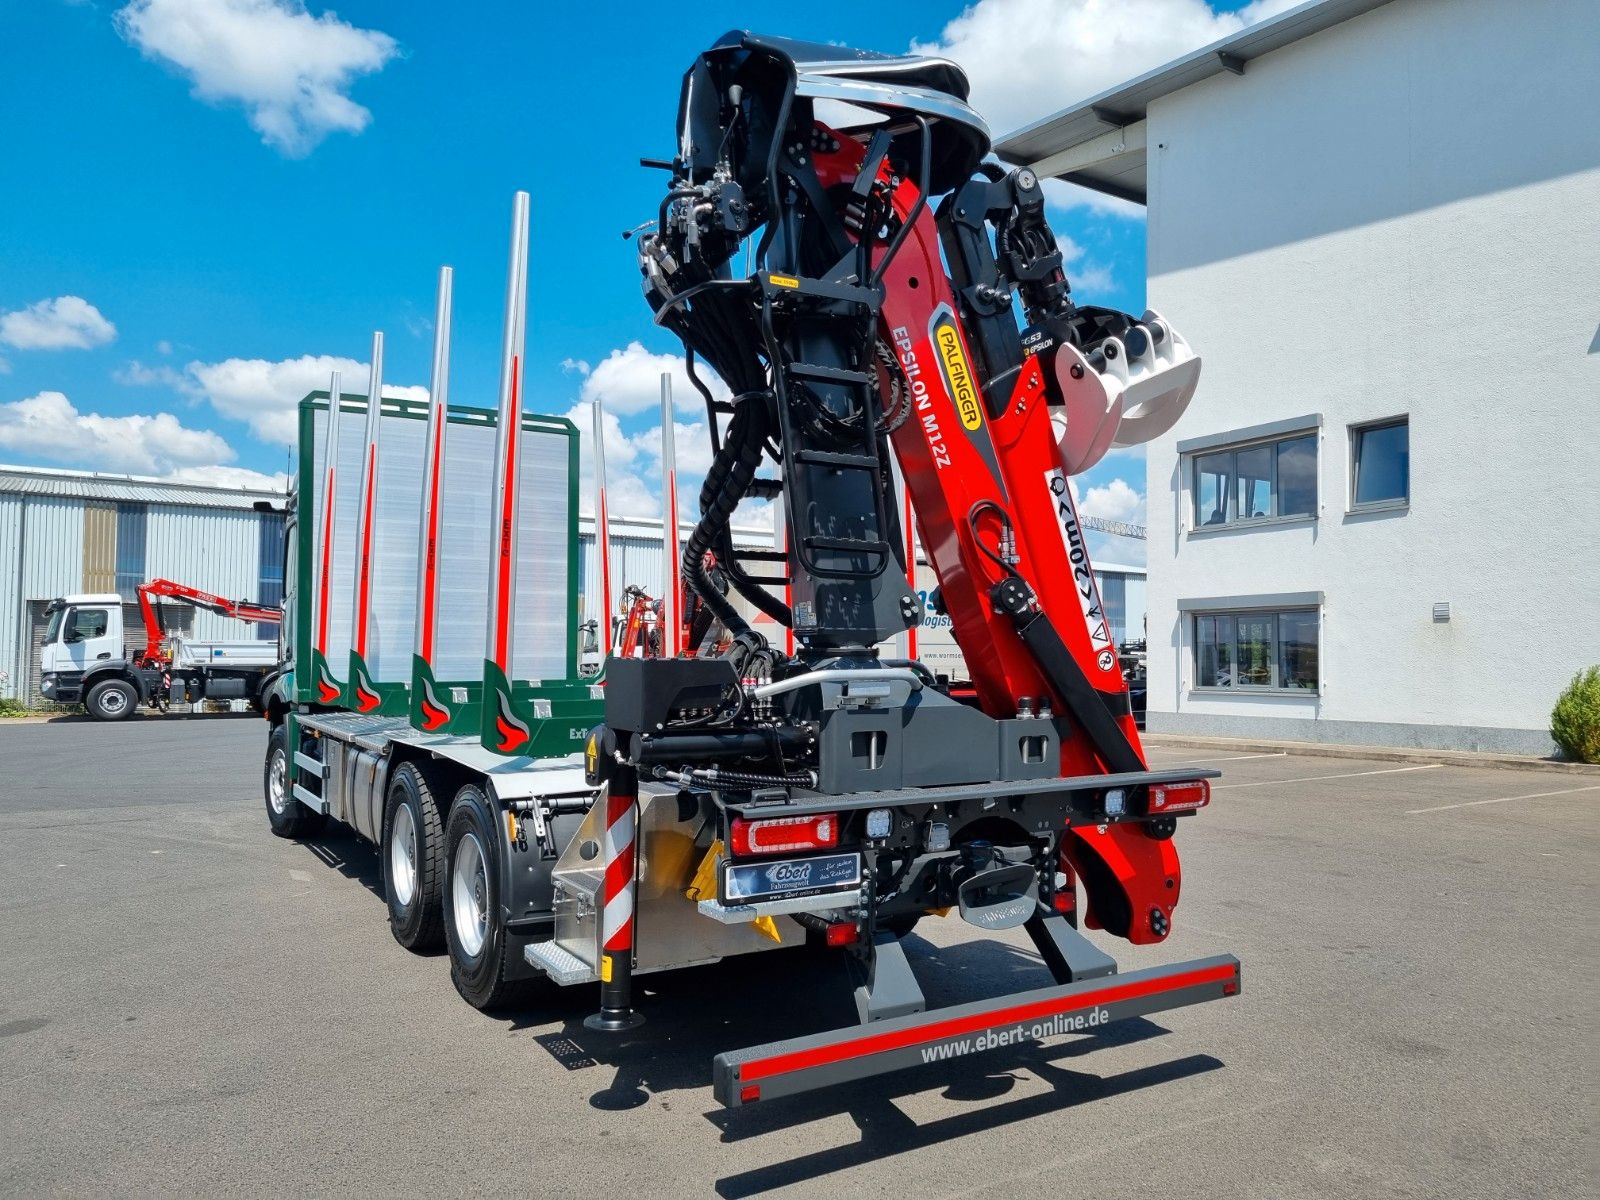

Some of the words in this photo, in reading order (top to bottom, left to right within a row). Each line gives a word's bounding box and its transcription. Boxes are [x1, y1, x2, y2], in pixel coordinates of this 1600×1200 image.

[940, 331, 977, 424] PALFINGER
[893, 326, 931, 411] EPSILON
[922, 413, 952, 470] M12Z
[921, 615, 953, 629] ogist
[570, 728, 588, 739] ExT
[776, 864, 810, 881] Ebert
[921, 1006, 1109, 1064] www.ebert-online.de
